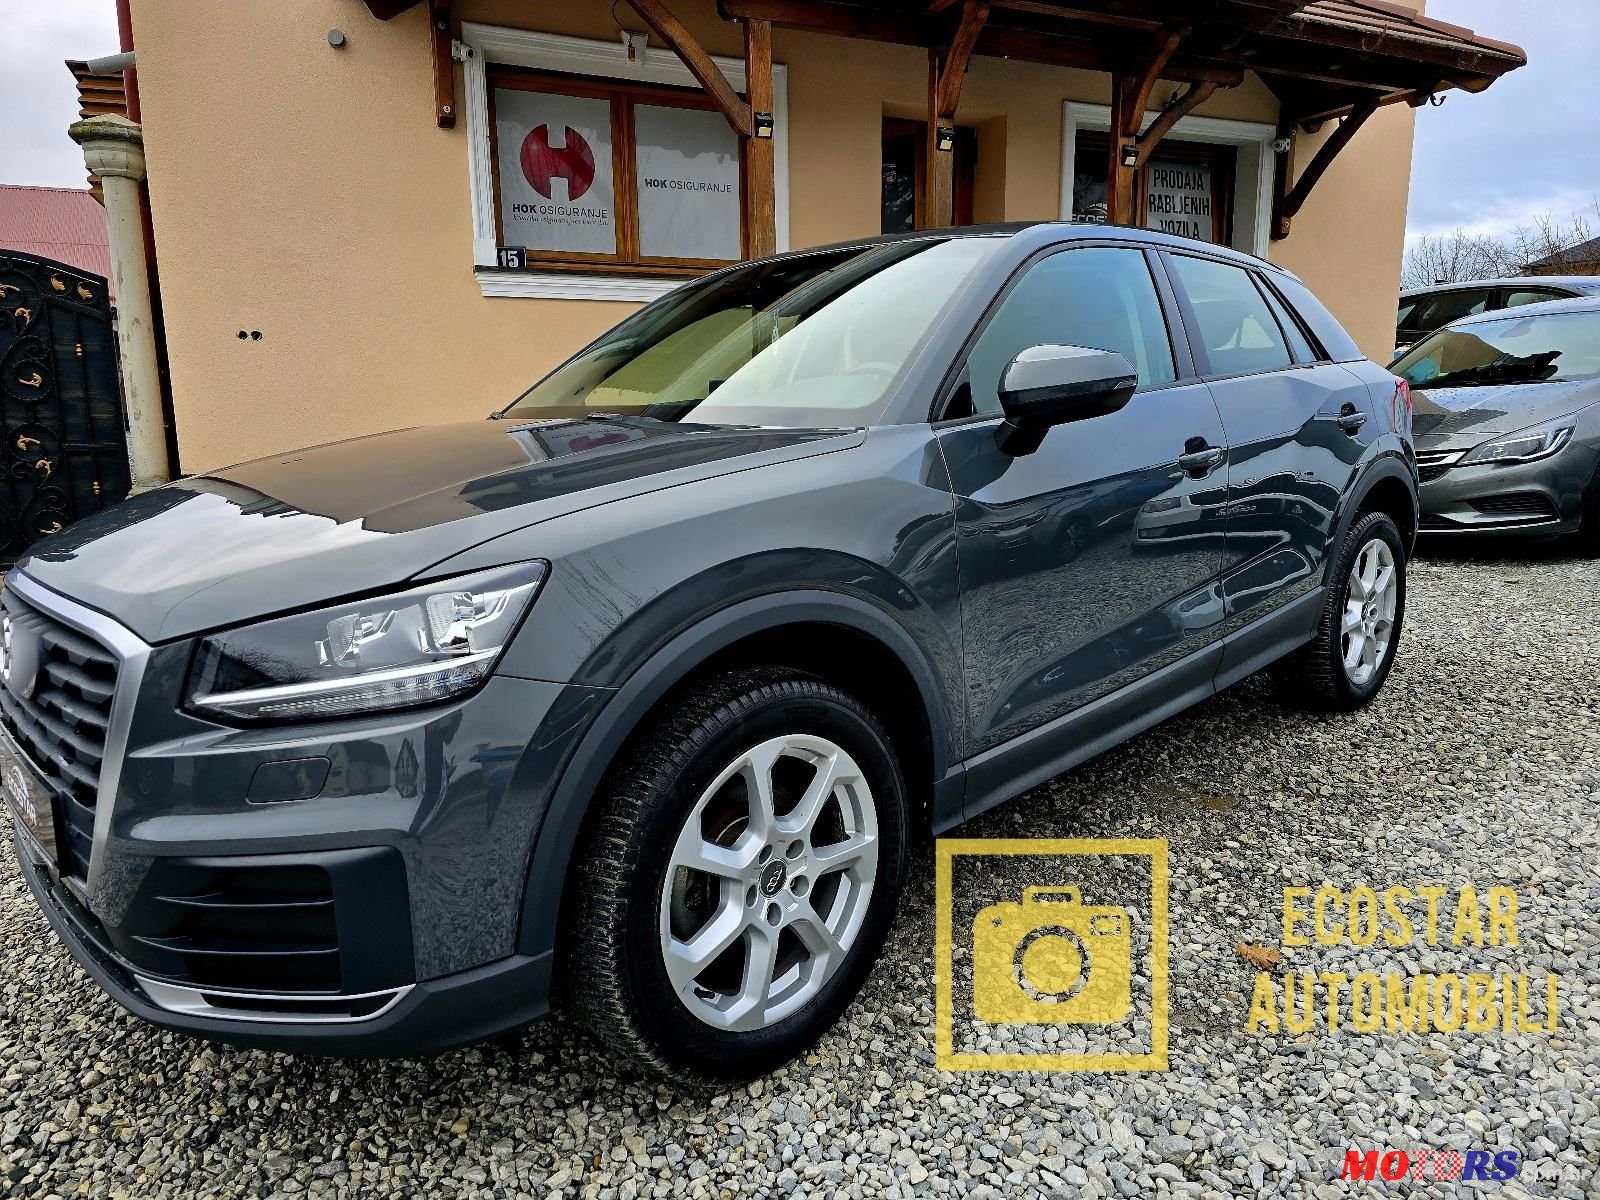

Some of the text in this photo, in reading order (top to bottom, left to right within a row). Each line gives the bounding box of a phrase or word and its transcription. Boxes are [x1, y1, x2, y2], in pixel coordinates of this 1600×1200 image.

[645, 178, 732, 193] HOK OSIGURANJE
[1153, 168, 1204, 191] PRODAJA
[512, 203, 608, 219] HOK OSIGURANJE
[1149, 193, 1210, 216] RABLJENIH
[1160, 219, 1201, 239] VOZILA
[500, 250, 519, 268] 15
